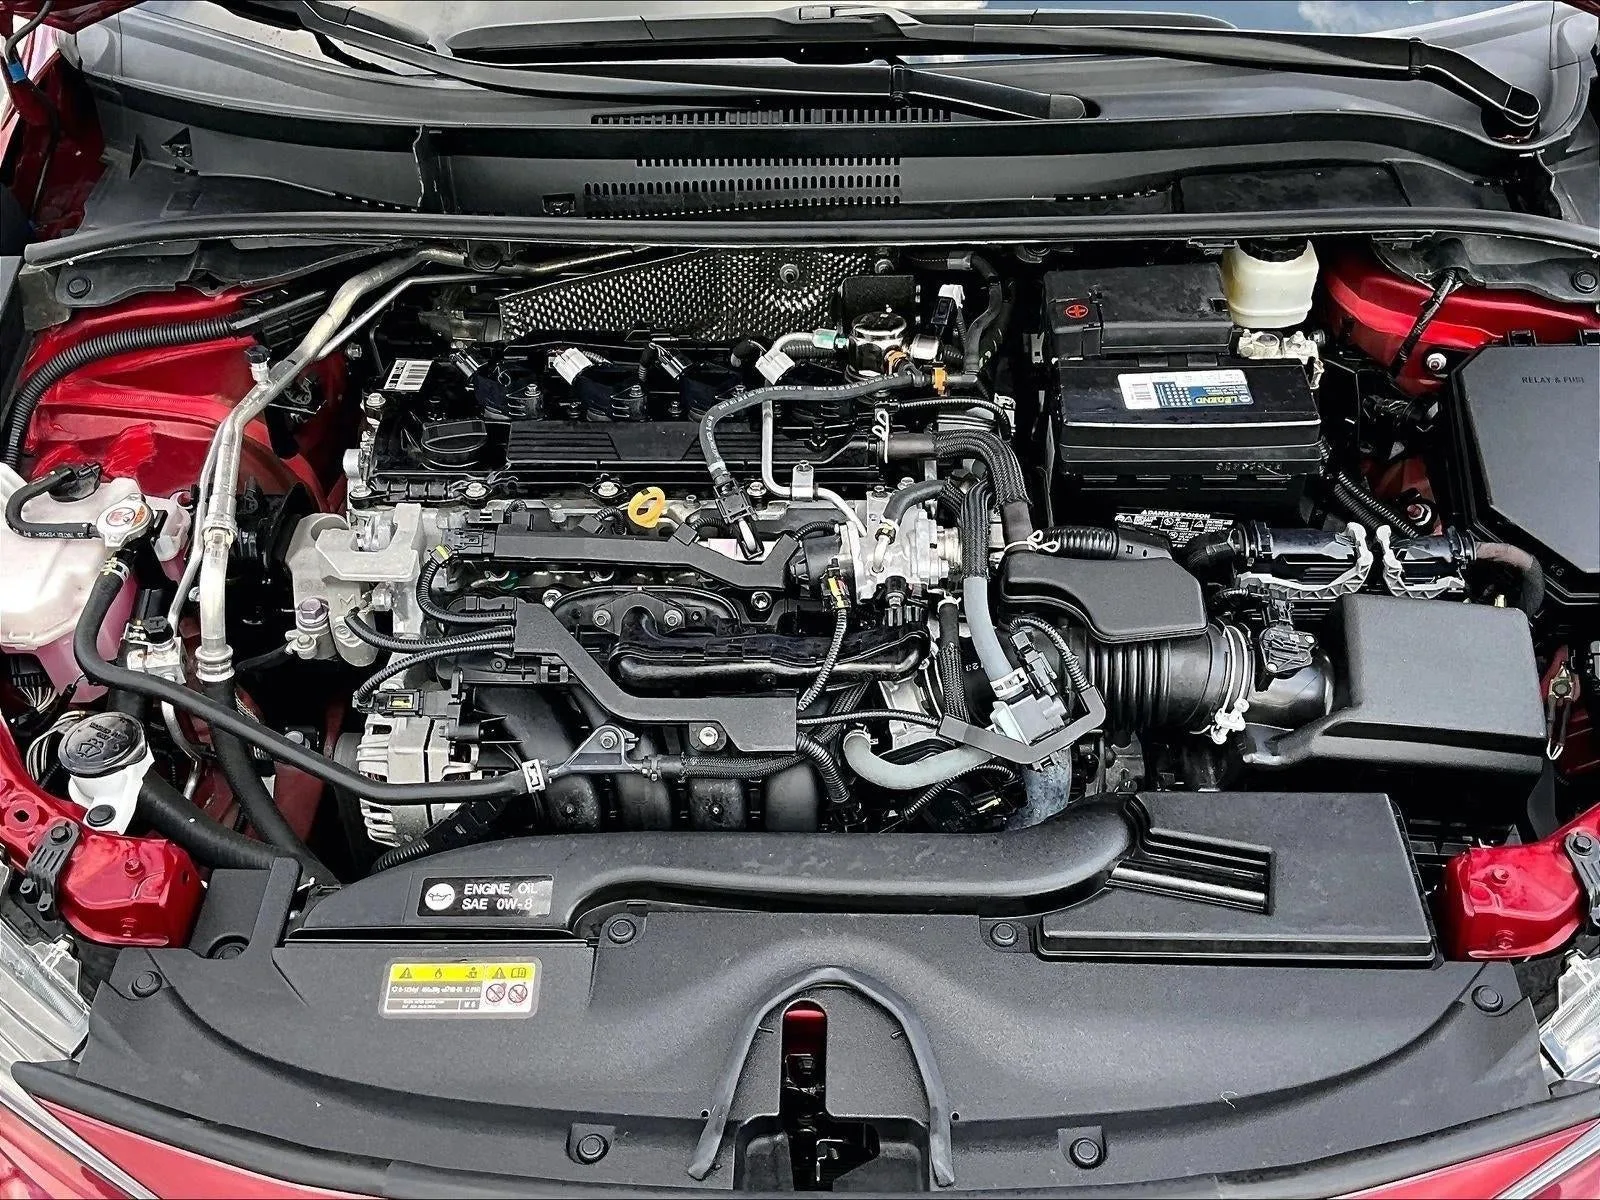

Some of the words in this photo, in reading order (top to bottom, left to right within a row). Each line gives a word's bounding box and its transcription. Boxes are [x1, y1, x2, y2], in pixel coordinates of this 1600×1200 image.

[463, 883, 511, 896] ENGINE
[517, 882, 538, 895] OIL
[461, 898, 488, 911] SAE
